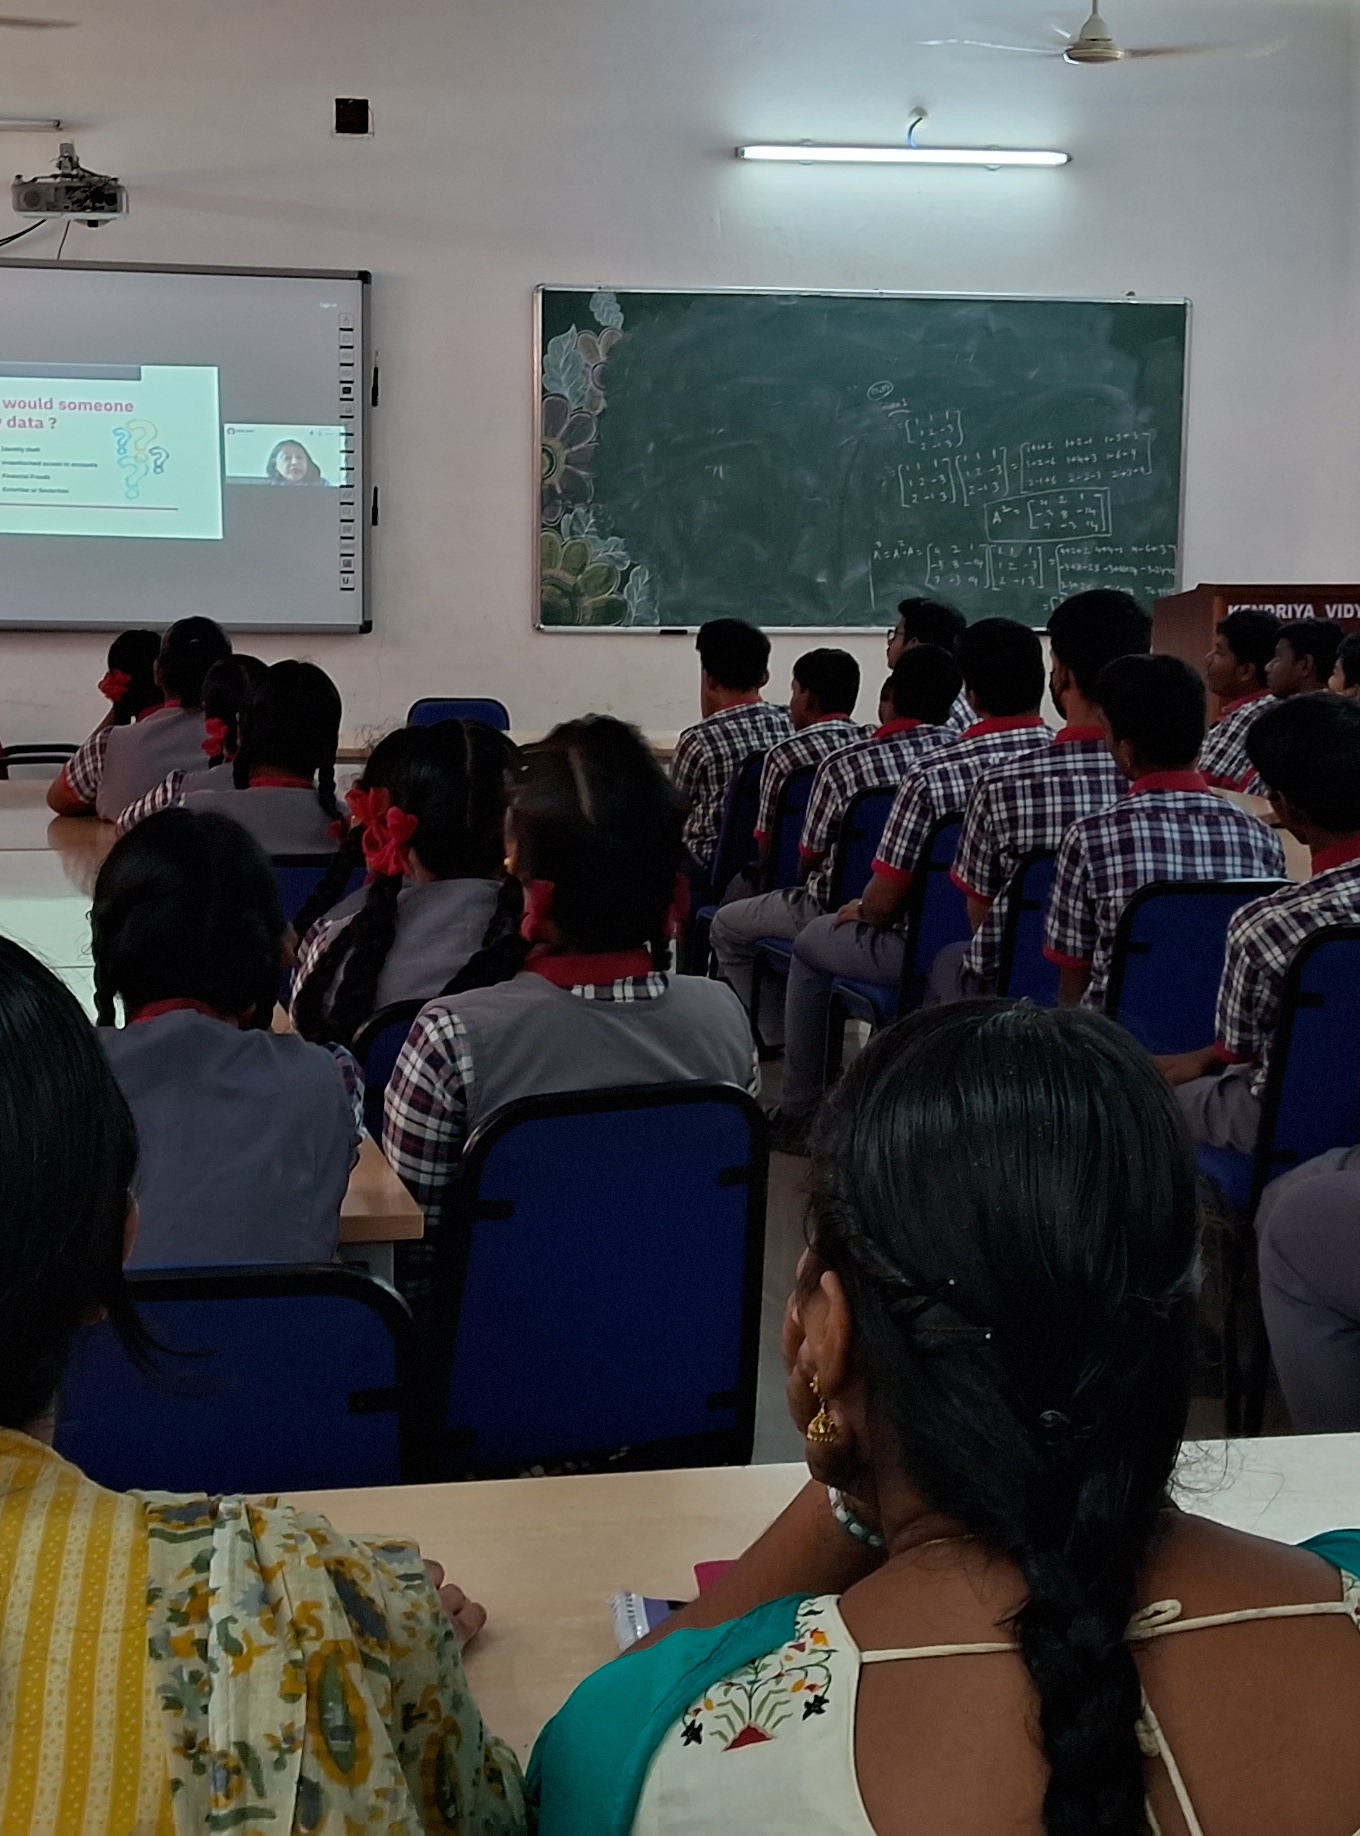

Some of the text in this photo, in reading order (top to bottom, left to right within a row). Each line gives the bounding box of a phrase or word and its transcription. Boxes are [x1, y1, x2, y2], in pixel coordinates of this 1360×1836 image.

[2, 397, 54, 410] would
[58, 400, 134, 413] someone
[6, 415, 44, 429] data
[49, 417, 57, 429] ?
